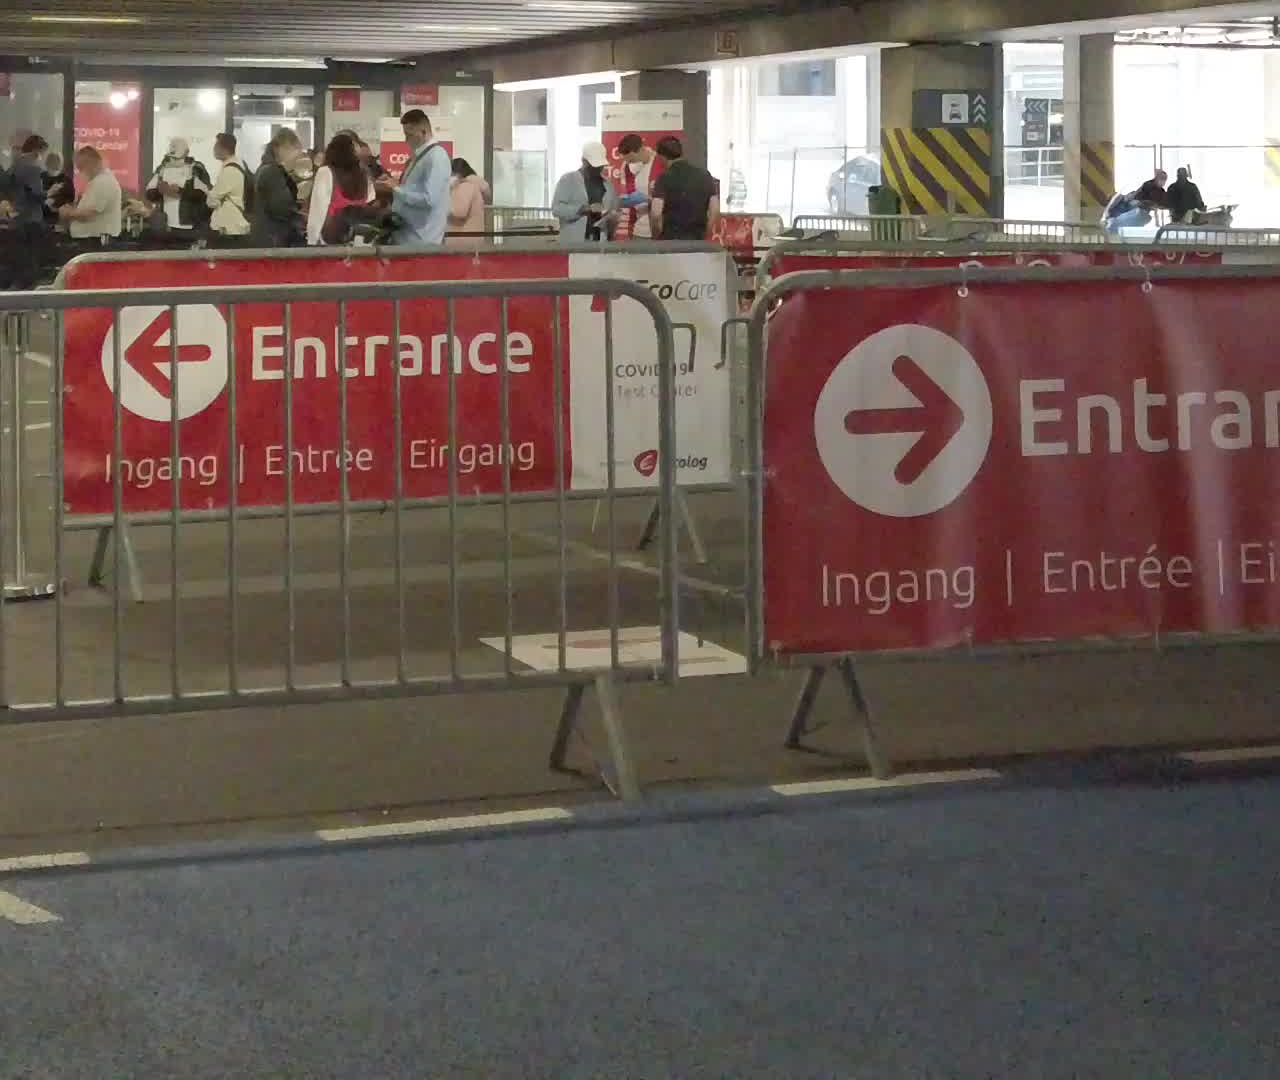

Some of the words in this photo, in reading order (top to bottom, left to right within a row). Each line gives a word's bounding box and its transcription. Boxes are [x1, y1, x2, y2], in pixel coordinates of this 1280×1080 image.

[251, 325, 535, 382] Entrance
[615, 363, 688, 378] COVI19
[104, 452, 217, 489] Ingang
[822, 563, 976, 615] Ingang
[1042, 544, 1193, 594] Entrée
